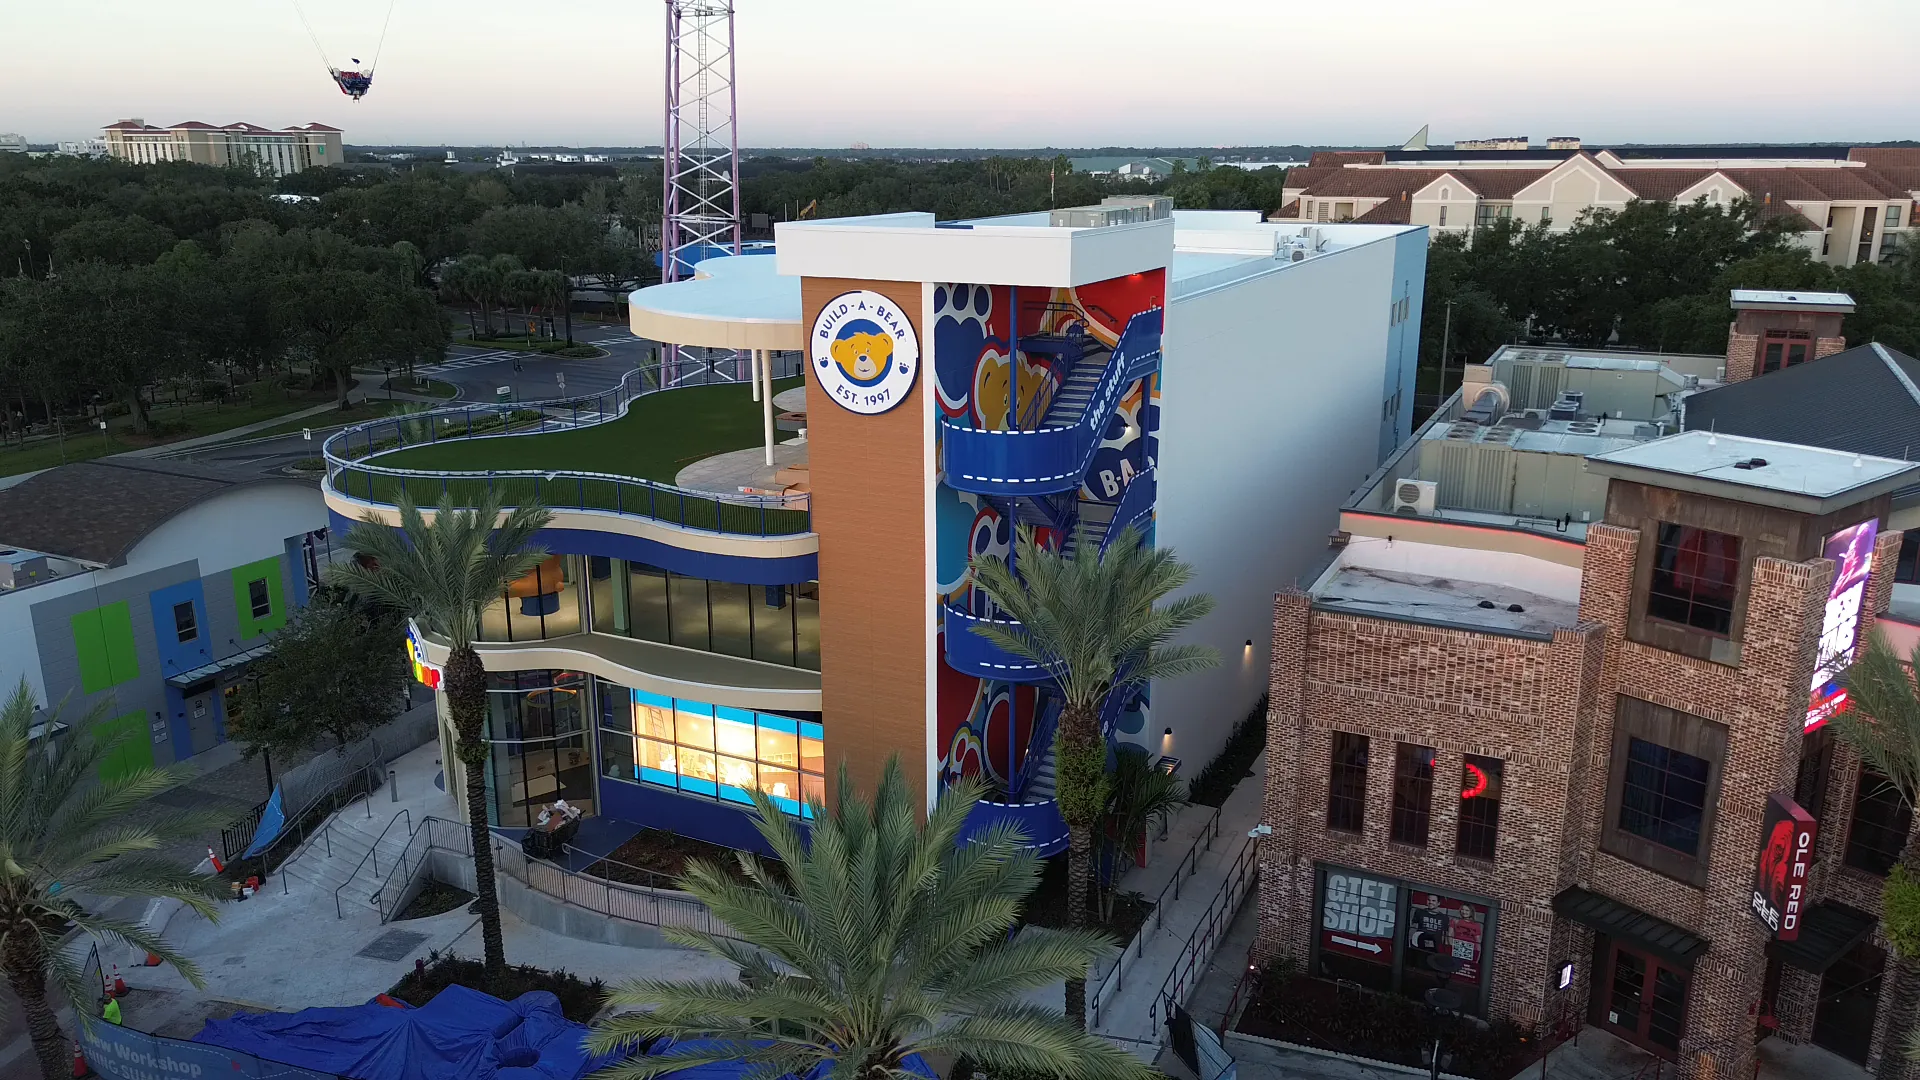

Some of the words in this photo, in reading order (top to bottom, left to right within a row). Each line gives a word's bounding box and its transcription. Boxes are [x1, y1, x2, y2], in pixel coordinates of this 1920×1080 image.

[836, 384, 859, 405] EST.
[864, 388, 891, 406] 1997
[1090, 400, 1106, 430] the
[1105, 352, 1125, 401] stuff
[1793, 832, 1810, 878] OLE
[1327, 874, 1395, 907] GIFT
[1753, 891, 1779, 919] OLE
[1784, 884, 1801, 930] RED
[1323, 902, 1396, 935] SHOP
[1752, 898, 1779, 932] RED
[114, 1041, 202, 1077] Workshop
